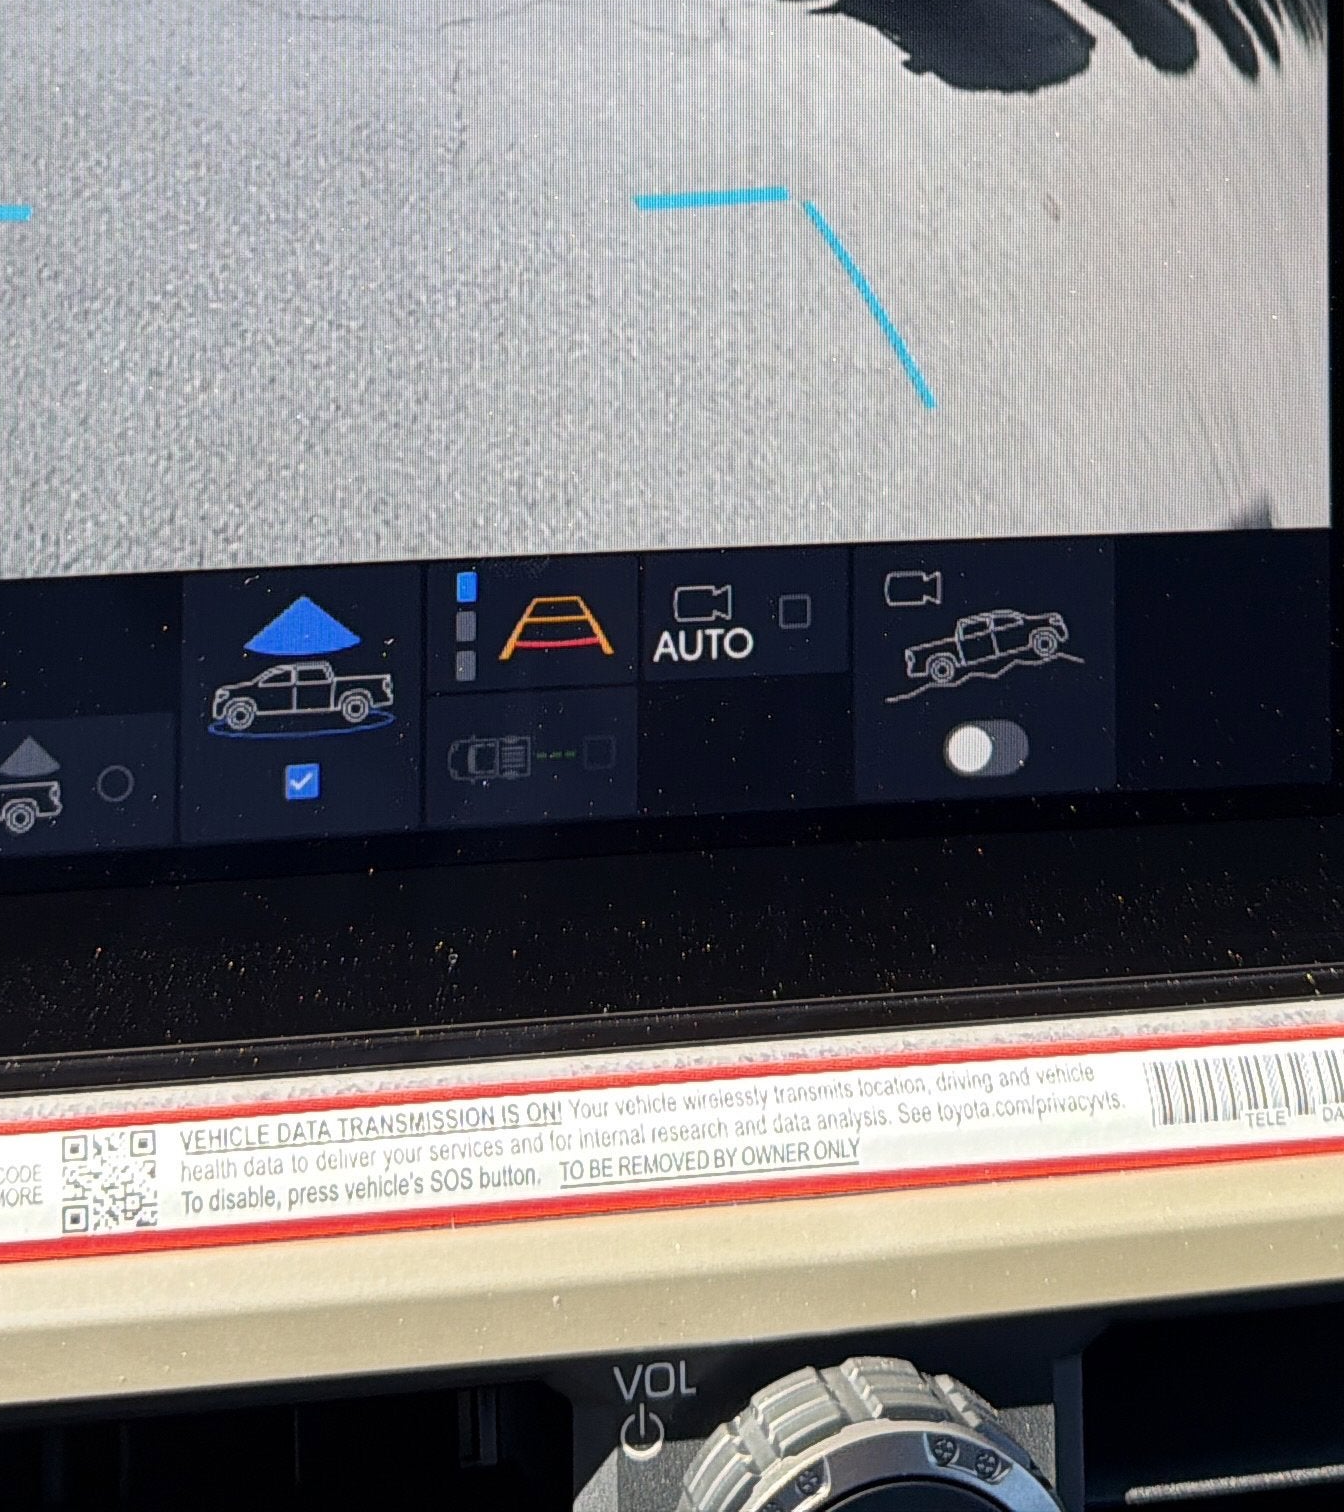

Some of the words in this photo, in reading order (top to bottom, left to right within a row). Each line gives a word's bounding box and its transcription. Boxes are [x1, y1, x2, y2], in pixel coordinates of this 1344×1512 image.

[653, 627, 754, 662] AUTO
[179, 1123, 270, 1152] VEHICLE
[277, 1119, 332, 1144] DATA
[337, 1105, 495, 1138] TRANSMISSION
[502, 1103, 520, 1124] IS
[526, 1100, 562, 1123] ON!
[568, 1098, 609, 1120] Your
[615, 1092, 677, 1116] vehicle
[682, 1085, 768, 1111] wirelessly
[773, 1078, 854, 1105] transmits
[935, 1069, 994, 1094] driving
[998, 1066, 1031, 1088] and
[1036, 1062, 1095, 1085] vehicle
[1244, 1110, 1287, 1129] TELE
[180, 1155, 237, 1183] health
[243, 1155, 284, 1178] data
[291, 1154, 309, 1174] to
[315, 1149, 377, 1172] deliver
[383, 1144, 423, 1172] your
[429, 1136, 504, 1162] services
[510, 1132, 544, 1155] and
[549, 1129, 572, 1152] for
[578, 1123, 646, 1150] internal
[651, 1117, 729, 1144] research
[734, 1113, 767, 1137] and
[772, 1111, 812, 1134] data
[817, 1105, 893, 1134] analysis.
[897, 1101, 932, 1124] See
[181, 1190, 204, 1215] To
[208, 1185, 282, 1212] disable,
[287, 1182, 340, 1212] press
[344, 1172, 424, 1201] vehicle's
[430, 1167, 473, 1193] SOS
[479, 1163, 542, 1189] button.
[558, 1159, 585, 1182] TO
[589, 1157, 613, 1179] BE
[618, 1149, 710, 1177] REMOVED
[714, 1147, 737, 1170] BY
[741, 1141, 811, 1167] OWNER
[813, 1136, 860, 1160] ONLY
[613, 1360, 697, 1400] VOL
